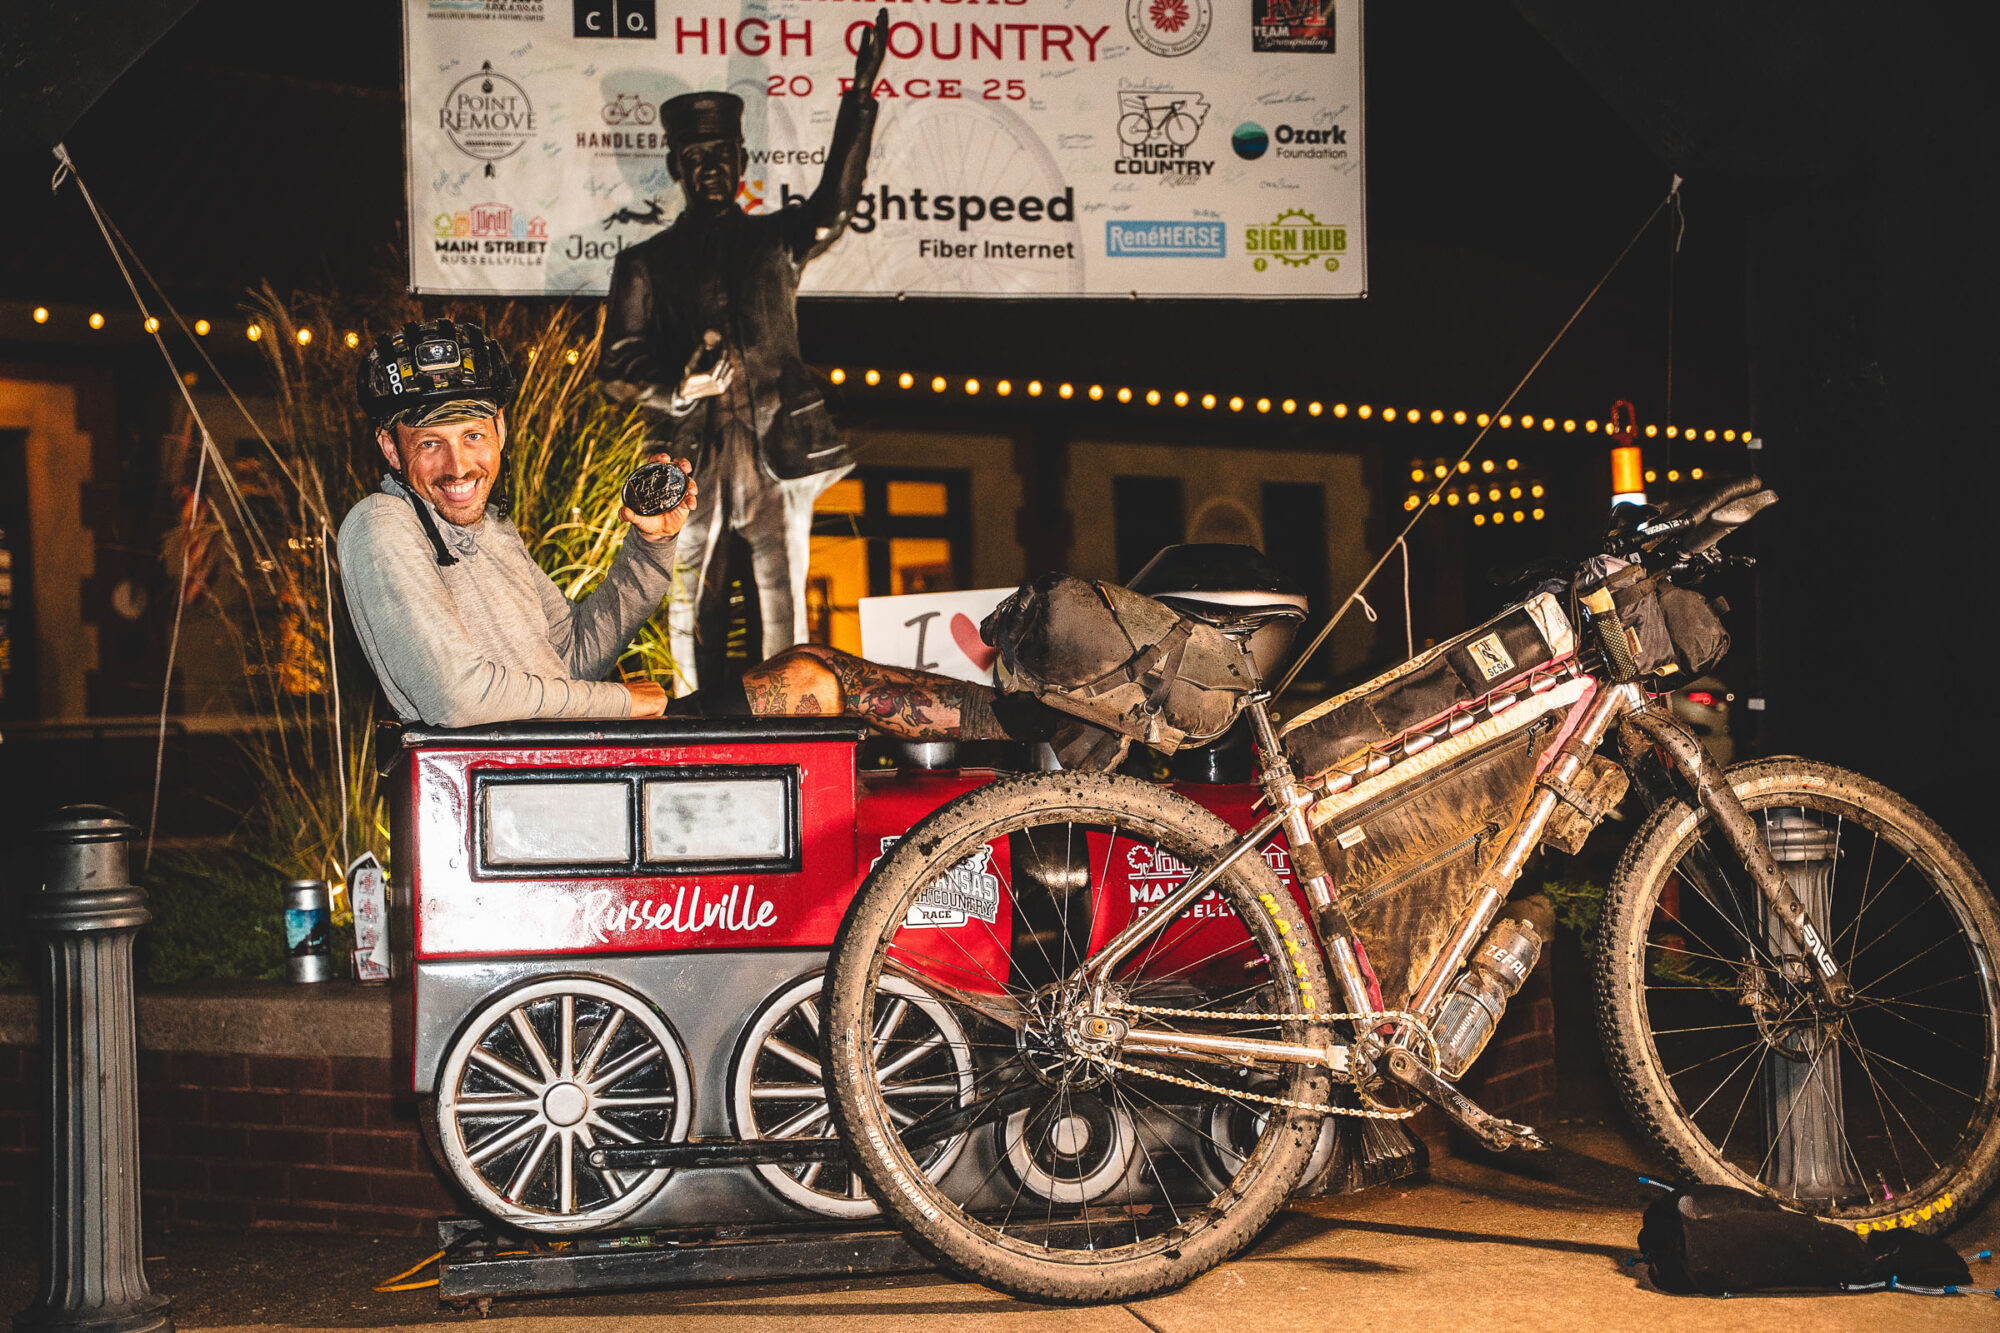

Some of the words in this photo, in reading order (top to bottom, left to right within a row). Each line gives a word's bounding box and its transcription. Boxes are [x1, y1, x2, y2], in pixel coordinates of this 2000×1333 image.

[676, 17, 813, 58] HIGH
[845, 20, 1110, 62] COUNTRY
[1253, 26, 1290, 37] TEAM
[767, 75, 813, 97] 20
[983, 79, 1026, 101] 25
[458, 93, 518, 112] POINT
[440, 108, 537, 134] REMOVE
[576, 132, 670, 149] HANDLEBA
[1275, 124, 1346, 145] Ozark
[1133, 143, 1184, 158] HIGH
[1276, 147, 1348, 159] Foundation
[1114, 160, 1215, 175] COUNTRY
[780, 183, 1075, 233] bghtspeed
[435, 241, 480, 254] MAIN
[484, 241, 547, 254] STREET
[919, 239, 976, 258] Fiber
[984, 240, 1075, 260] Internet
[1246, 229, 1297, 251] SIGN
[1302, 229, 1347, 251] HUB
[440, 254, 543, 266] RUSSELLVILLE
[905, 611, 941, 671] I
[1487, 662, 1509, 678] SCSW
[1130, 882, 1180, 903] MAI
[582, 884, 778, 943] Russellville
[922, 910, 952, 920] RACE
[1259, 893, 1317, 1010] MAXXIS
[1450, 1012, 1474, 1049] MAGNUM
[1855, 1192, 1953, 1236] MAXXIS
